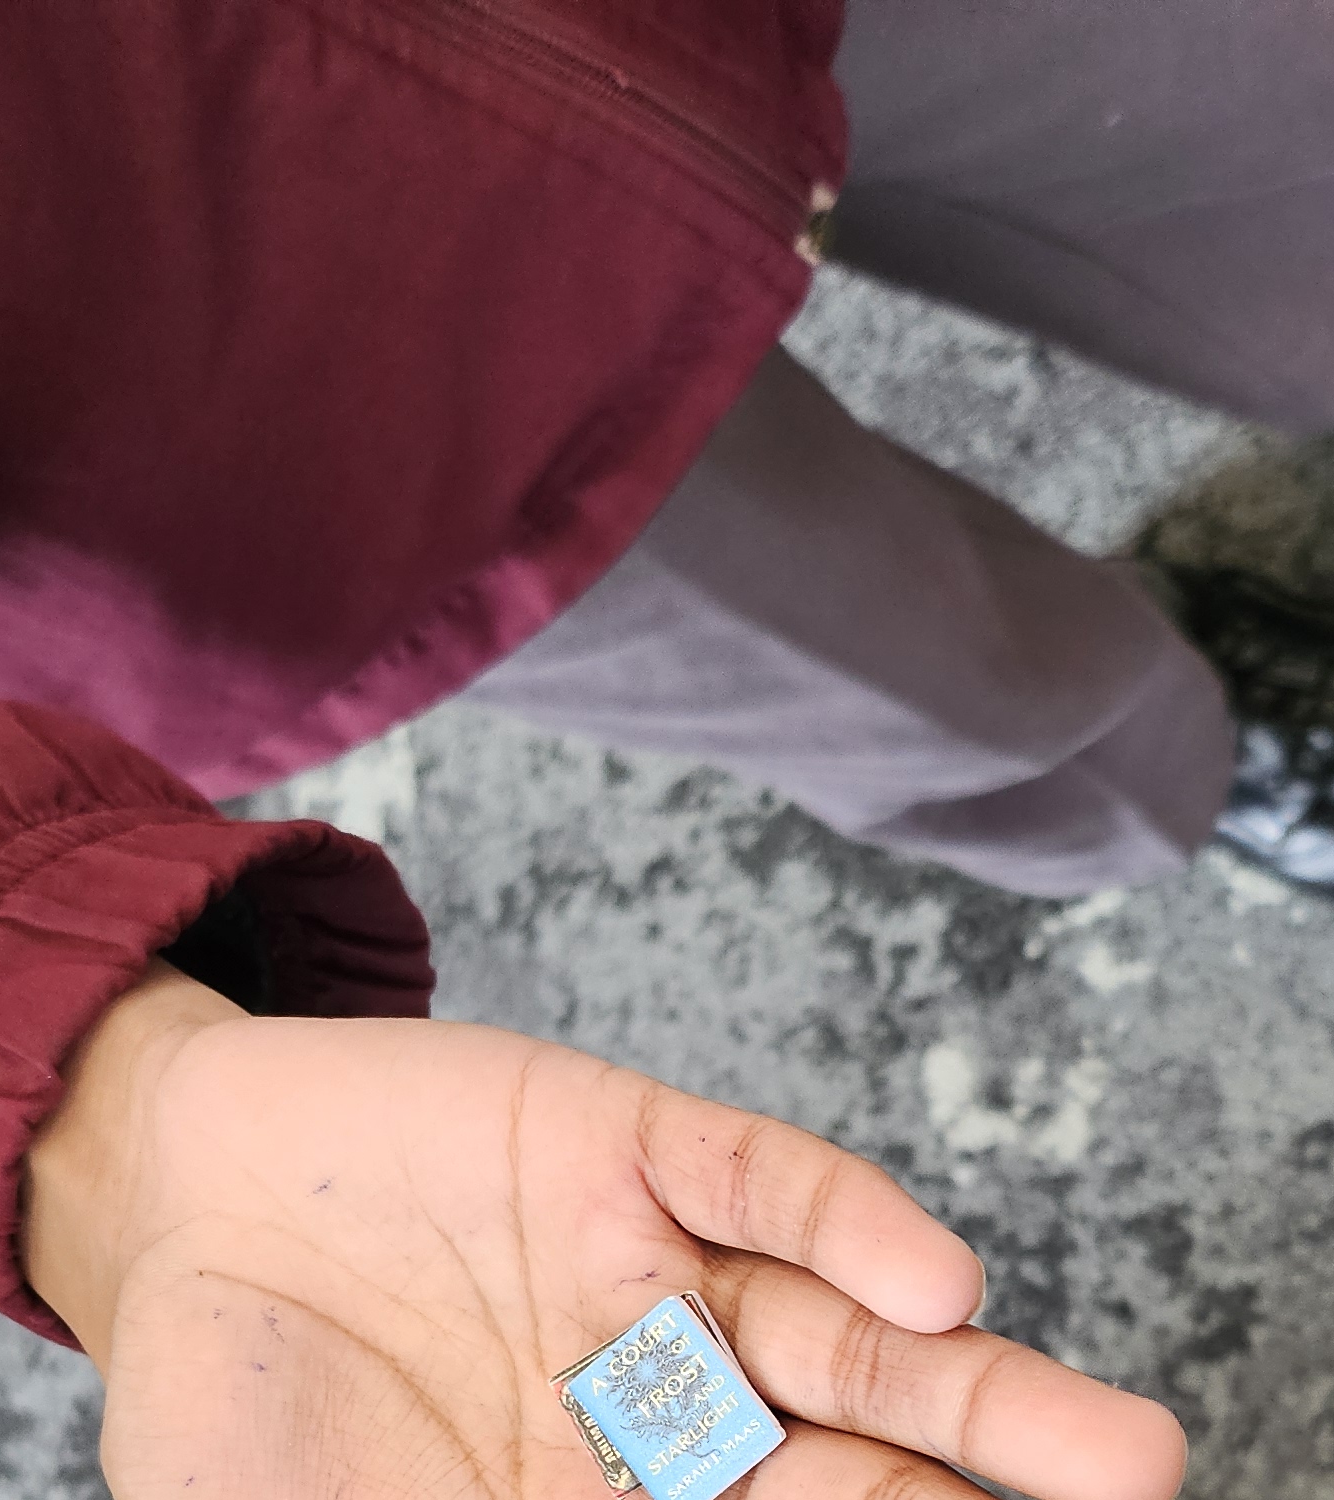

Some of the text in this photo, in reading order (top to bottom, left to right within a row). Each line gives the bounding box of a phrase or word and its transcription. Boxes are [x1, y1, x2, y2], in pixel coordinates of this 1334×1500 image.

[590, 1310, 677, 1396] A COURT
[670, 1332, 693, 1354] OF
[638, 1352, 709, 1419] FROST
[693, 1374, 725, 1408] AND
[647, 1391, 740, 1476] STARLIGHT
[667, 1460, 713, 1500] SARAH
[721, 1418, 761, 1452] MAAS
